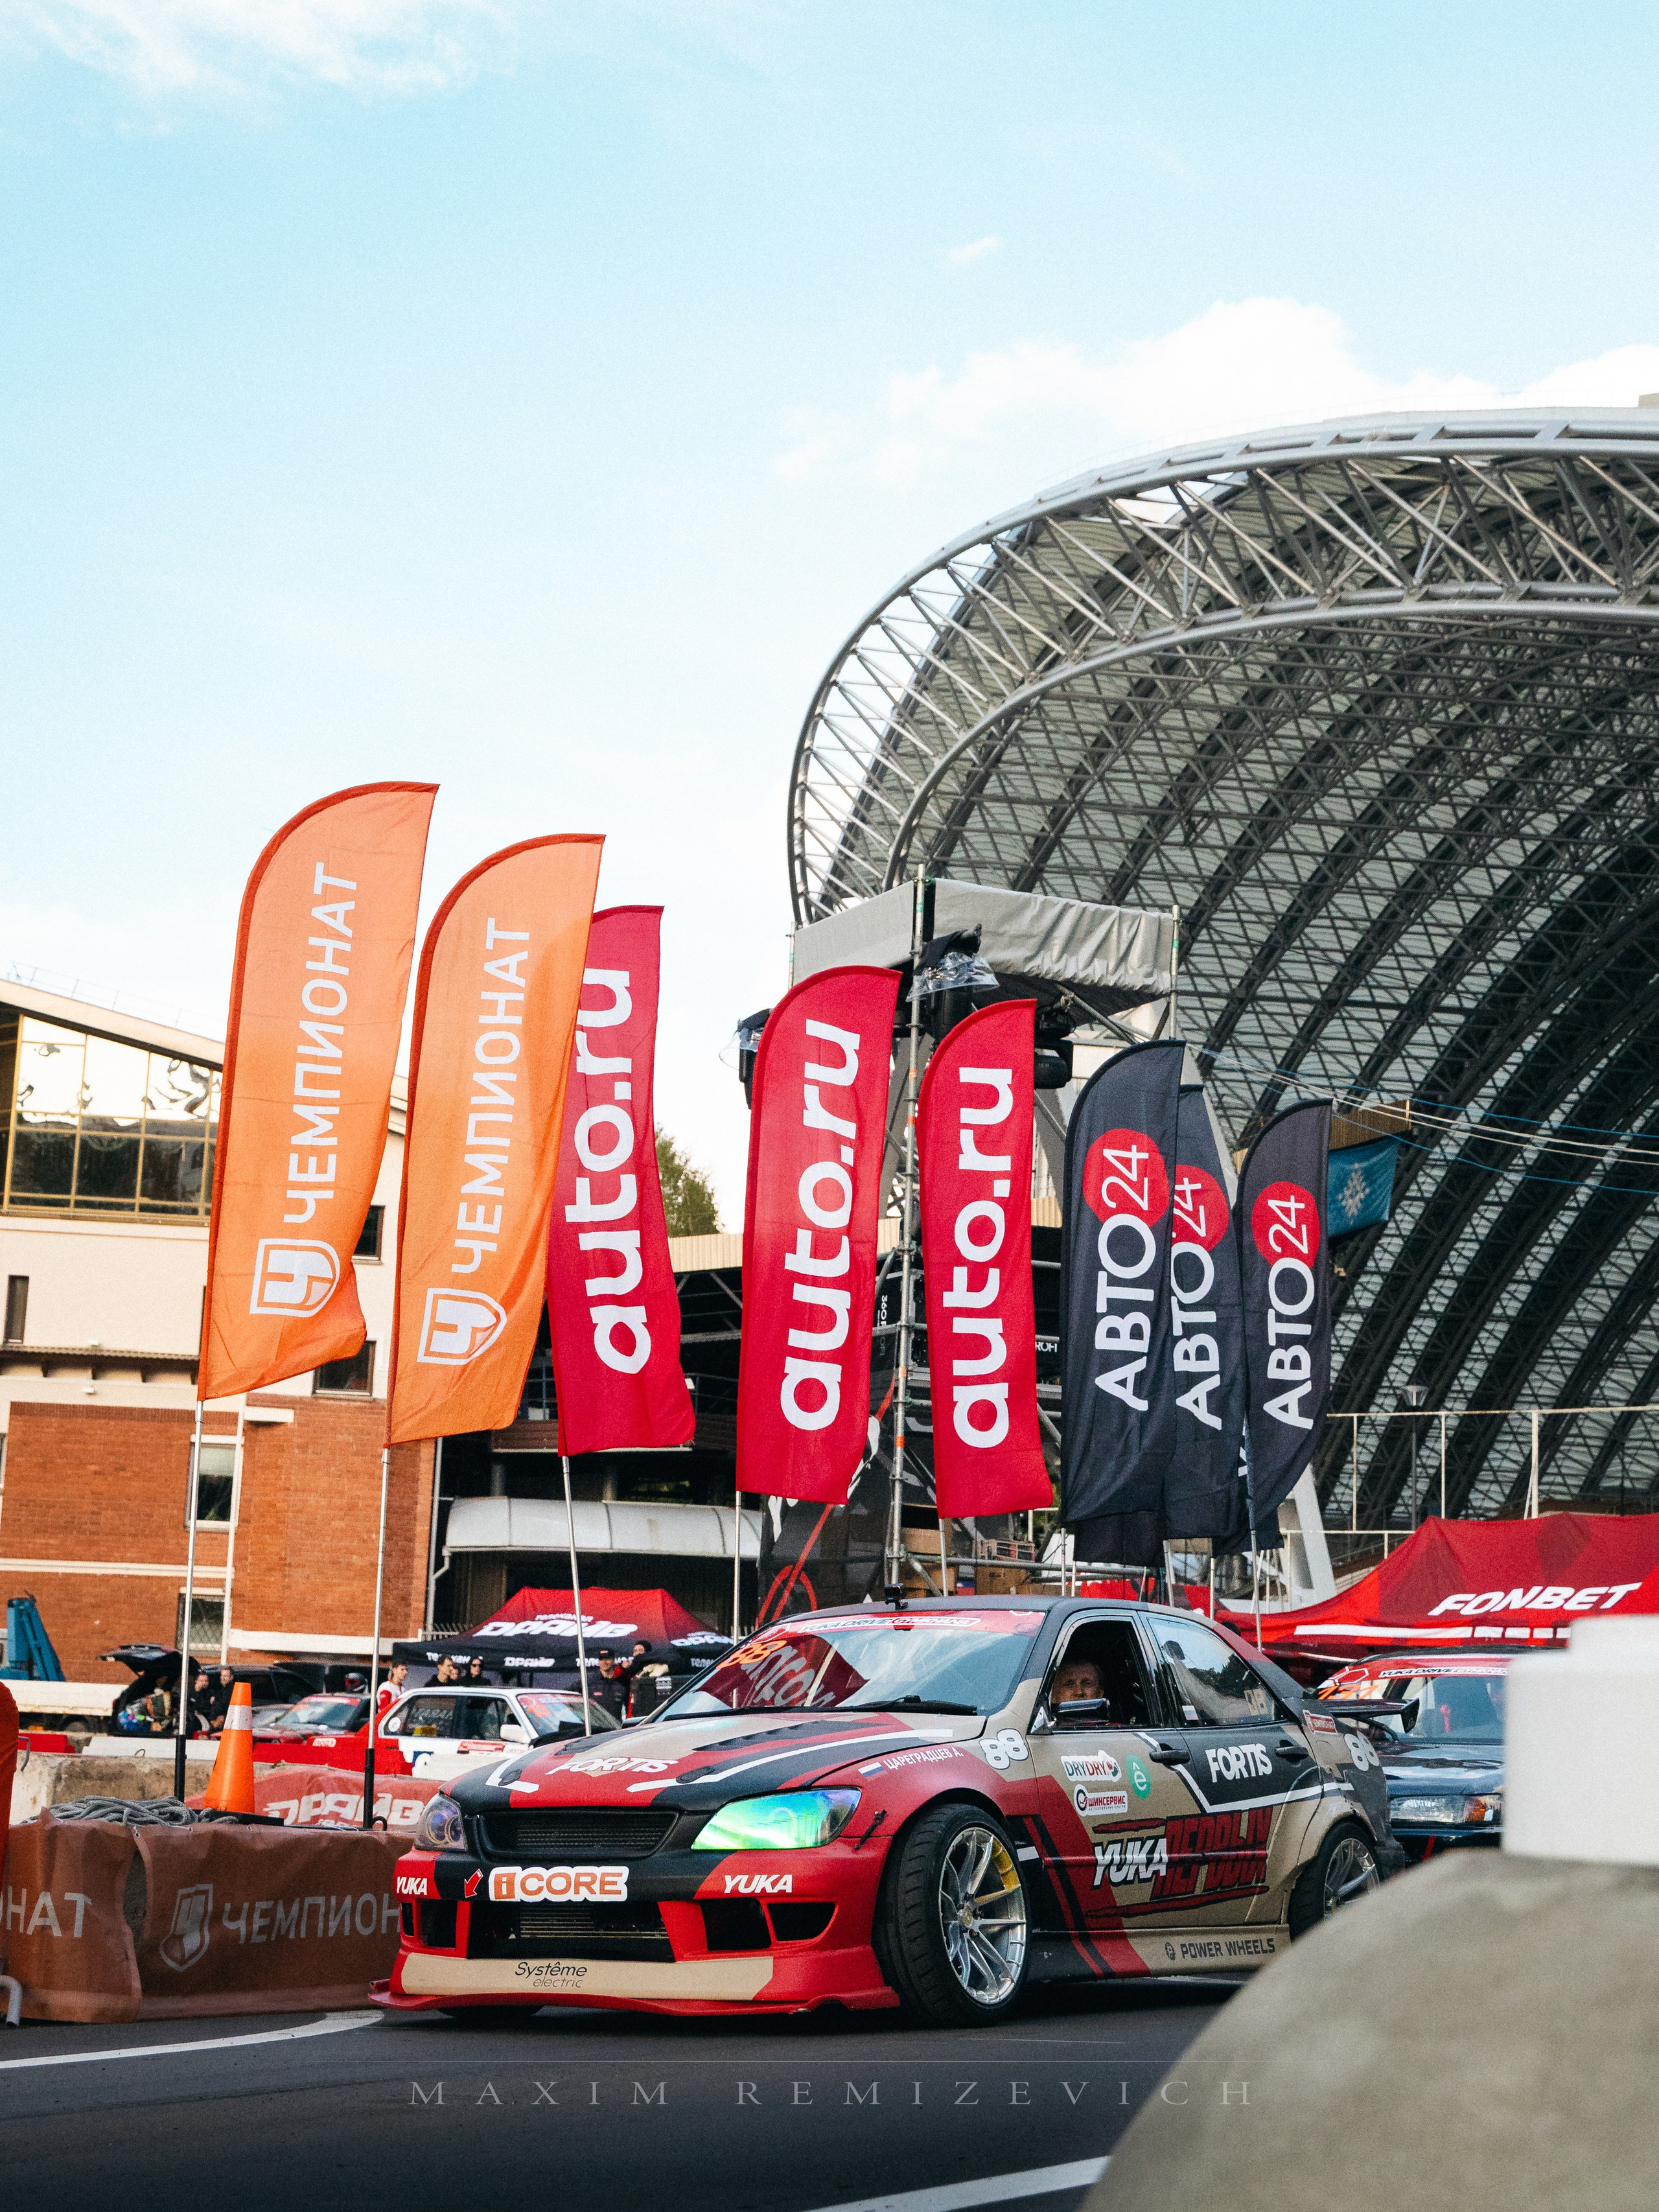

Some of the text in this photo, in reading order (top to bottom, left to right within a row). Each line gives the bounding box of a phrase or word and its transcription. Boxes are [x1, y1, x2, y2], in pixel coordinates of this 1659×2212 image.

[283, 862, 357, 1224] ЧЕМПИОНАТ
[452, 917, 530, 1274] ЧЕМПИОНАТ
[564, 968, 651, 1374] auto.ru
[780, 1019, 860, 1431] auto.ru
[942, 1067, 1014, 1448] auto.ru
[1428, 1582, 1642, 1616] FONBET
[472, 1619, 638, 1638] ДРАЙВ
[716, 1640, 787, 1670] 88
[1318, 1684, 1380, 1701] 131
[545, 1757, 679, 1775] FORTIS
[883, 1747, 964, 1770] ЦАРЕГРАДЦЕВ А.
[979, 1728, 1029, 1771] 88
[1205, 1743, 1273, 1782] FORTIS
[1343, 1730, 1380, 1771] 88
[1063, 1760, 1107, 1776] DRYDRY
[1088, 1795, 1126, 1807] ШИНСЕРВИС
[1094, 1838, 1168, 1885] YUKA
[397, 1876, 428, 1895] YUKA
[724, 1874, 793, 1894] YUKA
[0, 1886, 91, 1938] НАТ
[222, 1892, 400, 1944] ЧЕМПИОН
[1180, 1937, 1275, 1959] POWER WHEELS
[533, 1976, 583, 1988] electric
